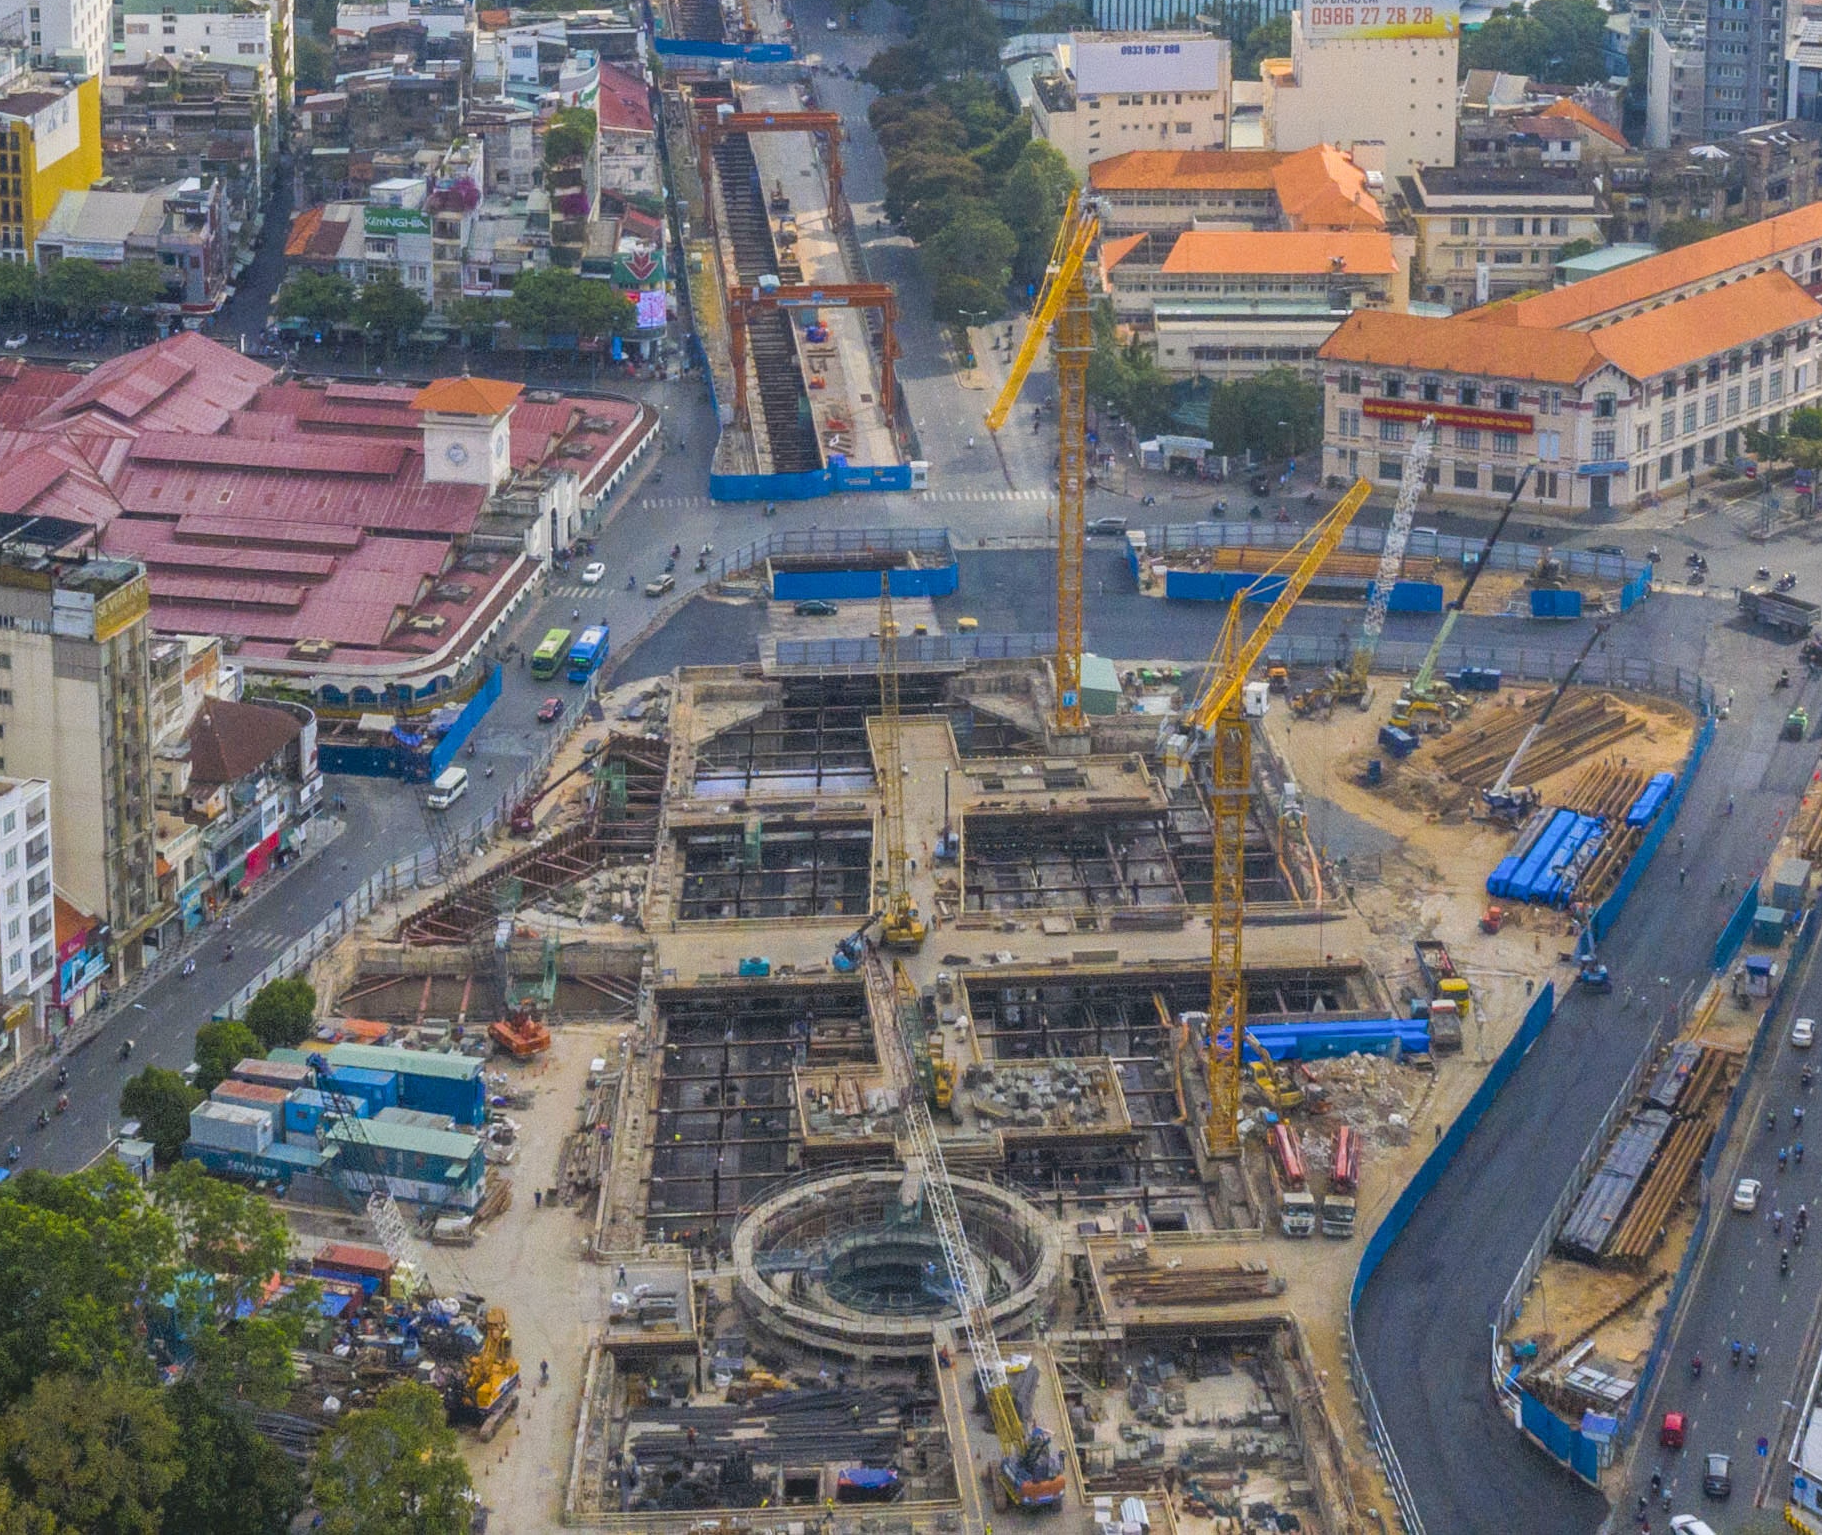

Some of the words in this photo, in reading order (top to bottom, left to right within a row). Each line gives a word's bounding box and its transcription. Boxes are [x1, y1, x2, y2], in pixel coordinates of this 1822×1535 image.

[1311, 6, 1355, 25] 0986
[1360, 6, 1380, 25] 27
[1386, 6, 1407, 25] 28
[1413, 6, 1433, 25] 28
